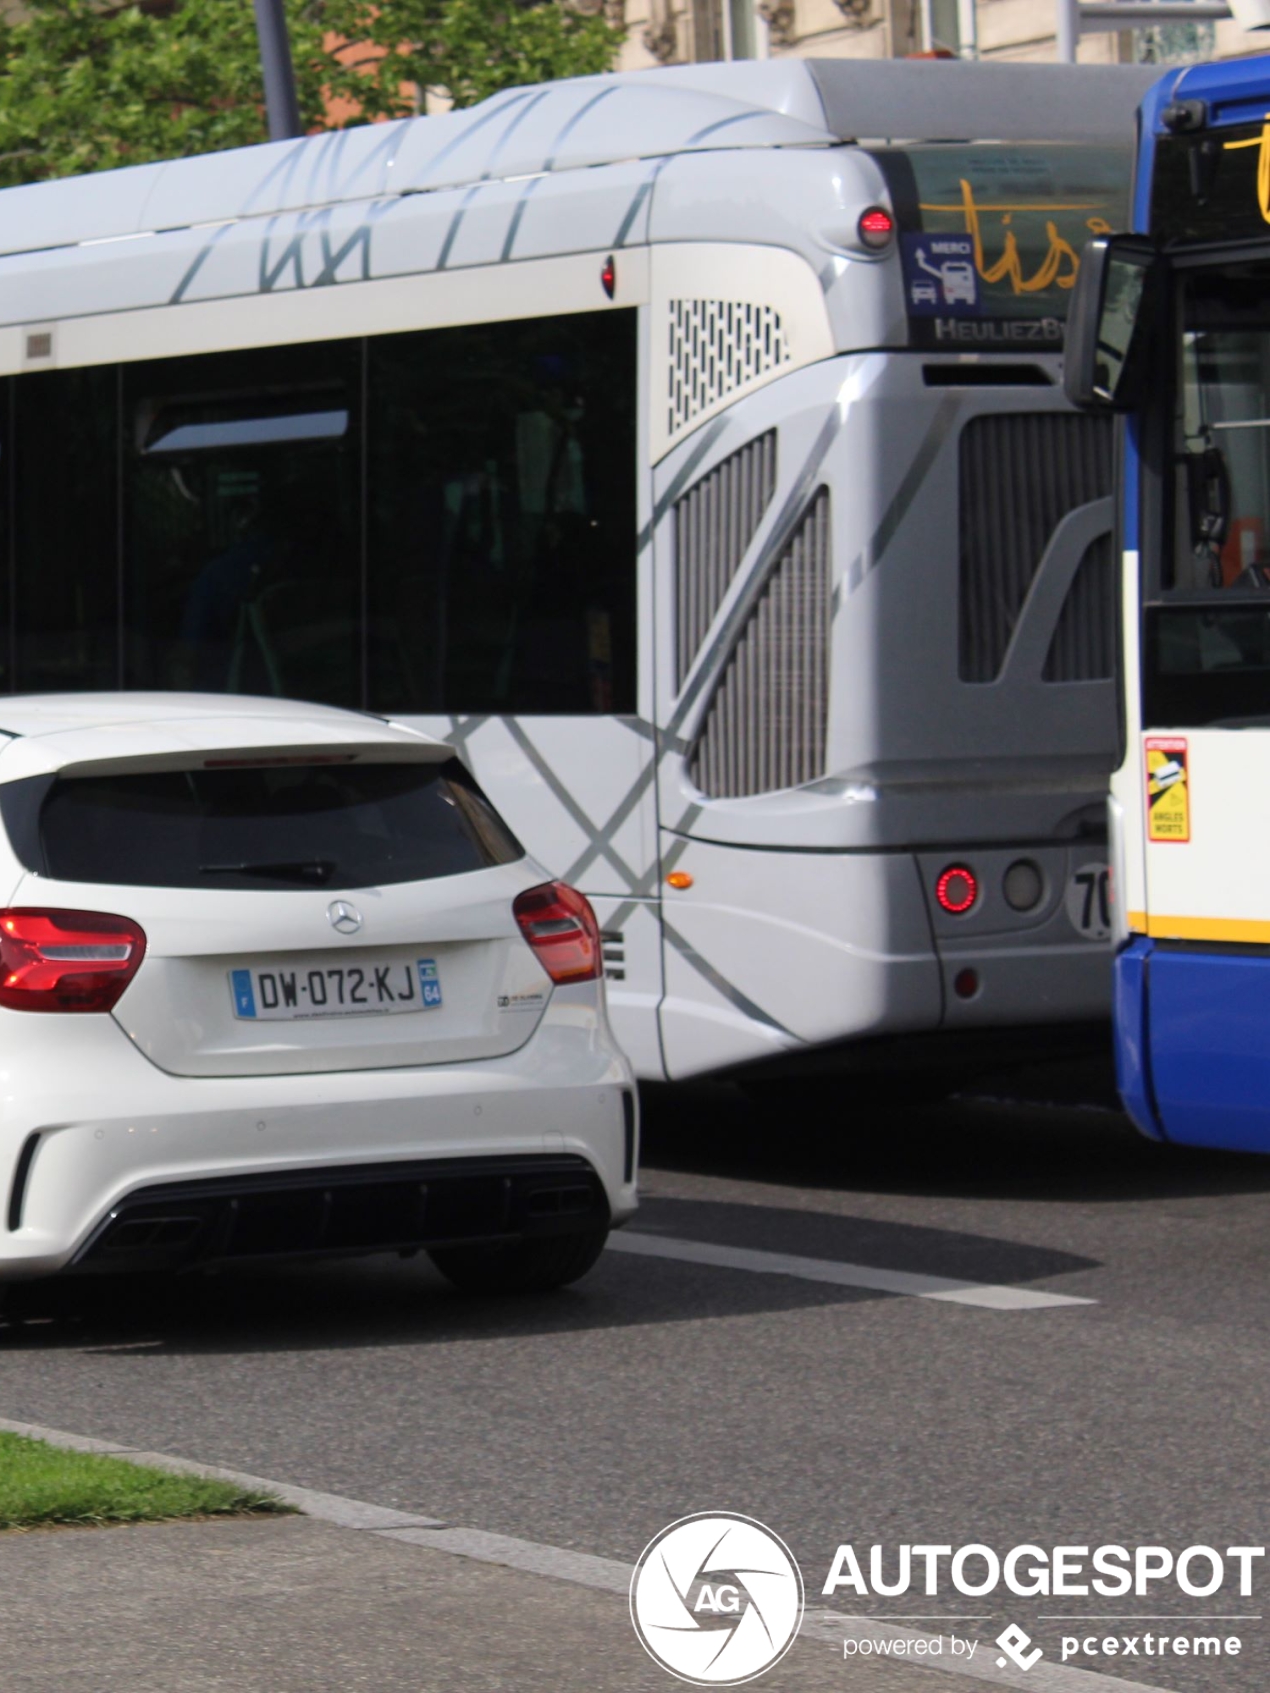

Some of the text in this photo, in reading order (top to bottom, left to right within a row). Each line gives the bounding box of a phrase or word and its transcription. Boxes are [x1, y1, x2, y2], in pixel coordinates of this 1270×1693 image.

[931, 242, 971, 255] MERCI
[258, 964, 415, 1009] DW-072-KJ
[423, 985, 440, 1002] 64
